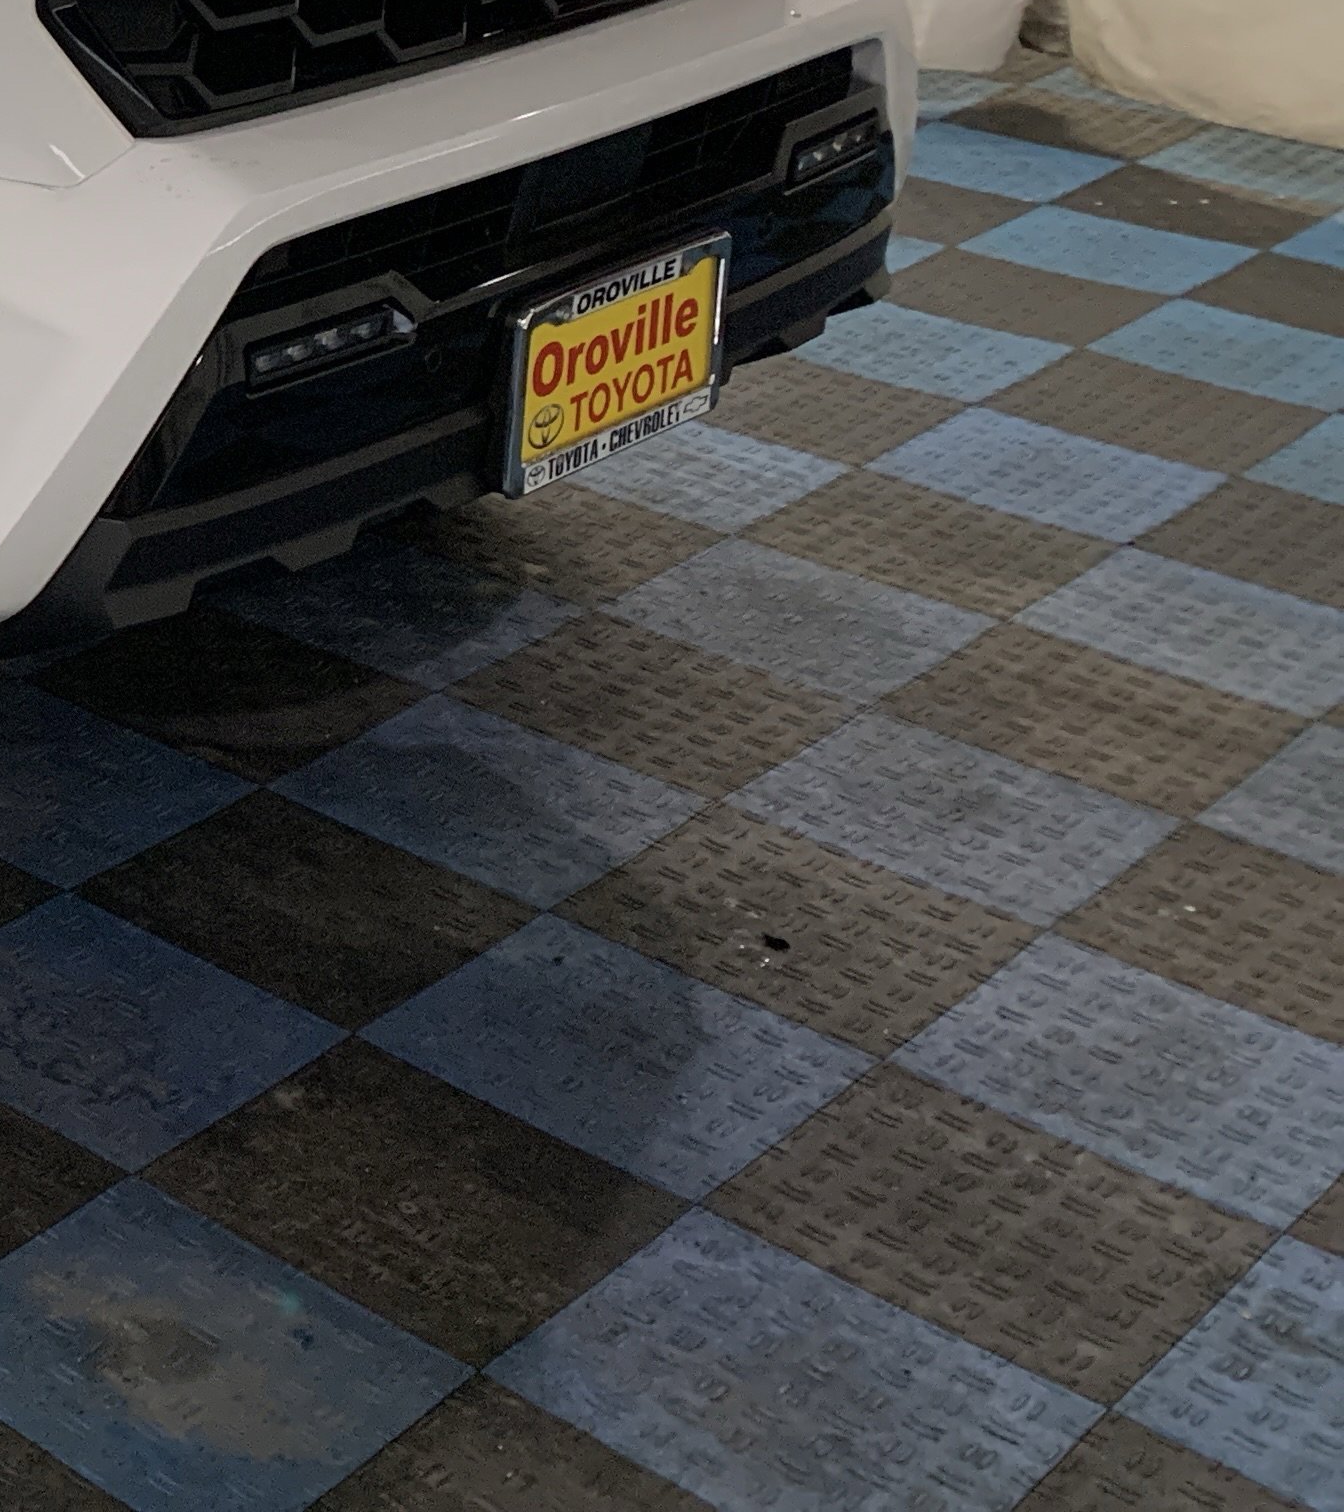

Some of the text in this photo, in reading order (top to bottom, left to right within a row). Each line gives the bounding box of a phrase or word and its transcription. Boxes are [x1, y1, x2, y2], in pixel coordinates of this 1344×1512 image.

[577, 258, 677, 315] OROVILLE
[532, 292, 699, 397] Oroville
[570, 349, 694, 432] TOYOTA
[548, 439, 600, 480] TOYOTA
[609, 400, 682, 452] CHEVROLET
